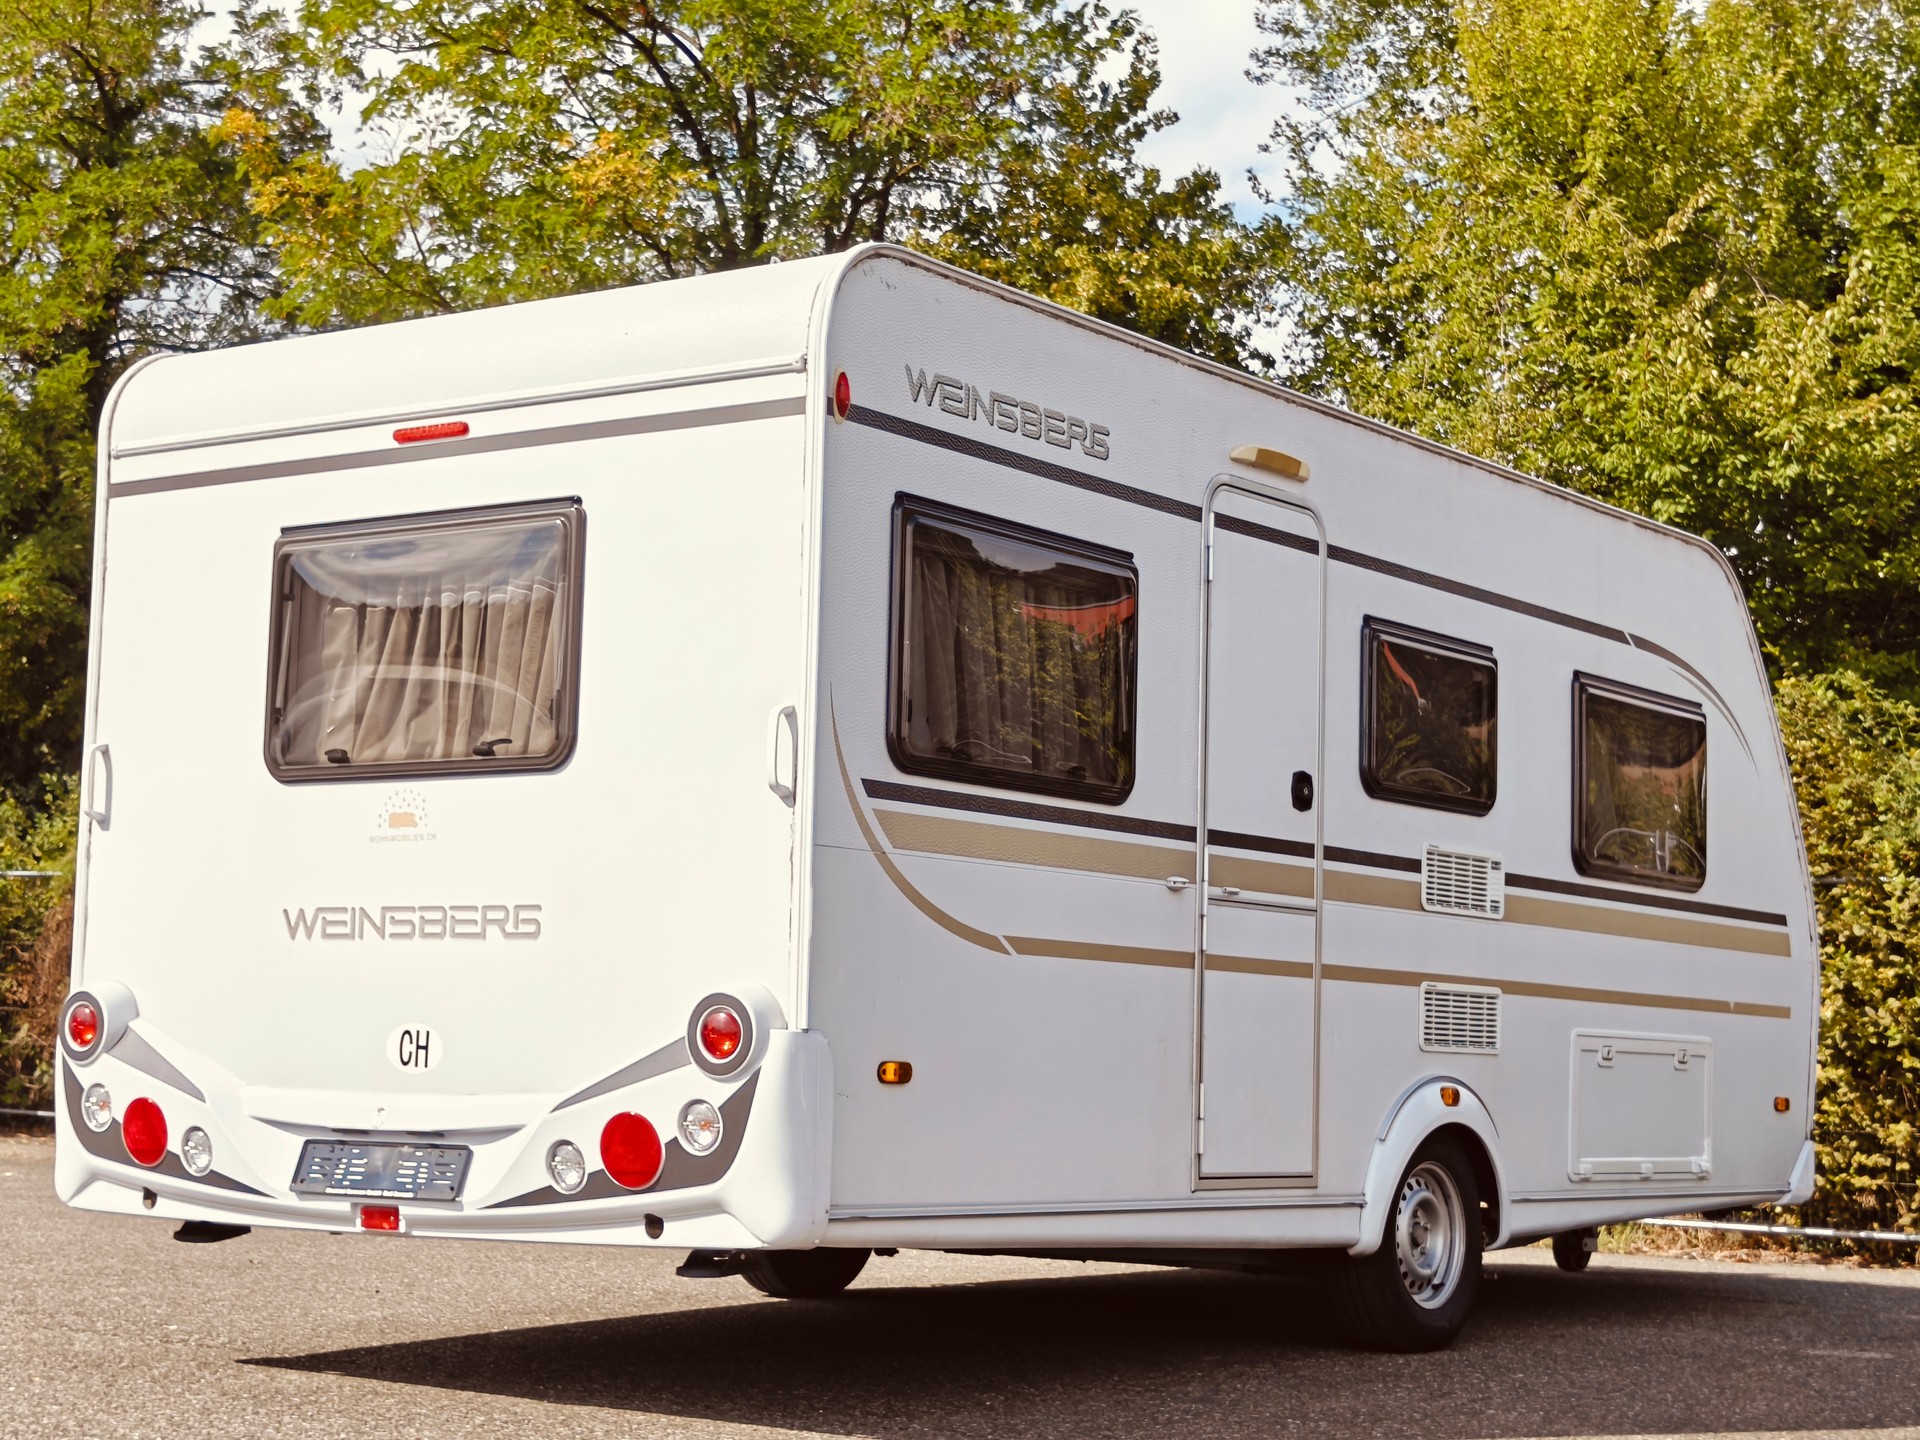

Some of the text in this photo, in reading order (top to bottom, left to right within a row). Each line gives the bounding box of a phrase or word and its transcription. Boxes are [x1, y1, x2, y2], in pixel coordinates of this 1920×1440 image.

[905, 363, 1110, 461] WEINSBERG
[283, 904, 542, 941] WEINSBERG
[399, 1029, 430, 1068] CH
